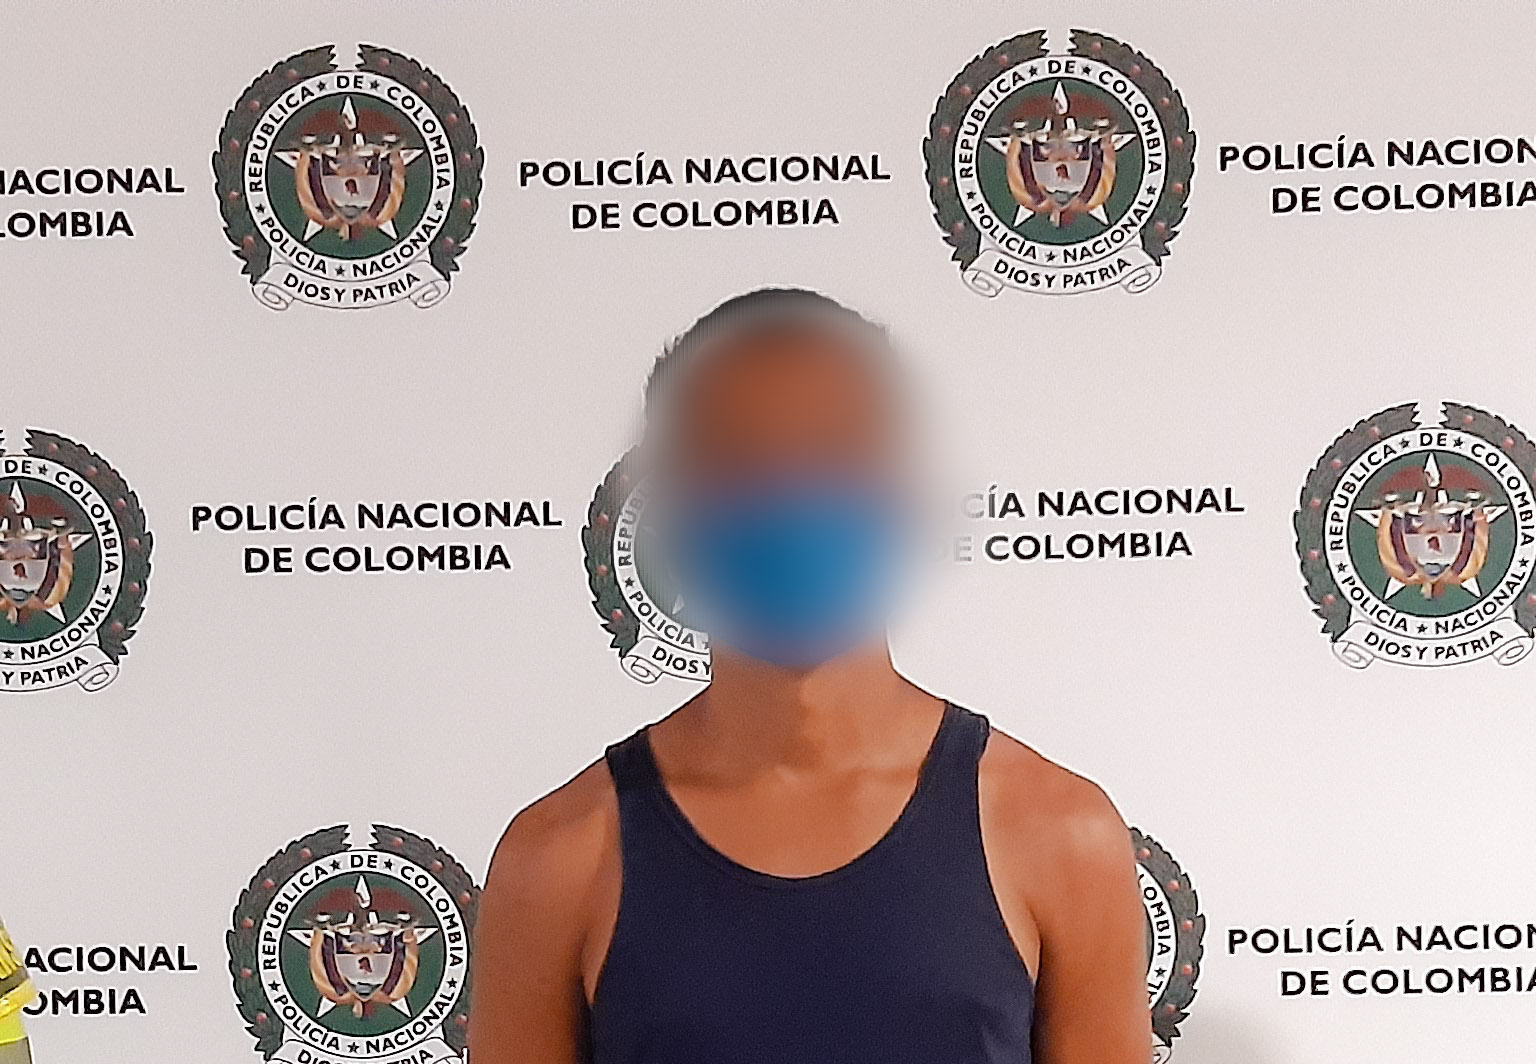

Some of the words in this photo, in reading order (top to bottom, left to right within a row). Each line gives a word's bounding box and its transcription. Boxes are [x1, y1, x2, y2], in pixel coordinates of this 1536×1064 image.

[1048, 60, 1076, 74] DE
[1099, 70, 1162, 174] COLOMBIA
[1220, 135, 1374, 171] POLICÍA
[520, 152, 673, 187] POLICÍA
[686, 155, 890, 184] NACIONAL
[573, 203, 620, 229] DE
[633, 199, 839, 227] COLOMBIA
[1273, 187, 1320, 214] DE
[1064, 199, 1153, 262] NACIONAL
[1063, 257, 1131, 288] PATRIA
[4, 460, 33, 474] DE
[55, 471, 118, 574] COLOMBIA
[193, 497, 345, 531] POLICÍA
[358, 501, 562, 529] NACIONAL
[1039, 487, 1244, 517] NACIONAL
[245, 548, 292, 573] DE
[305, 545, 511, 572] COLOMBIA
[985, 532, 1192, 561] COLOMBIA
[21, 598, 110, 660] NACIONAL
[20, 655, 89, 685] PATRIA
[1228, 919, 1384, 954] POLICÍA
[24, 946, 197, 973] ACIONAL
[1281, 971, 1329, 996] DE
